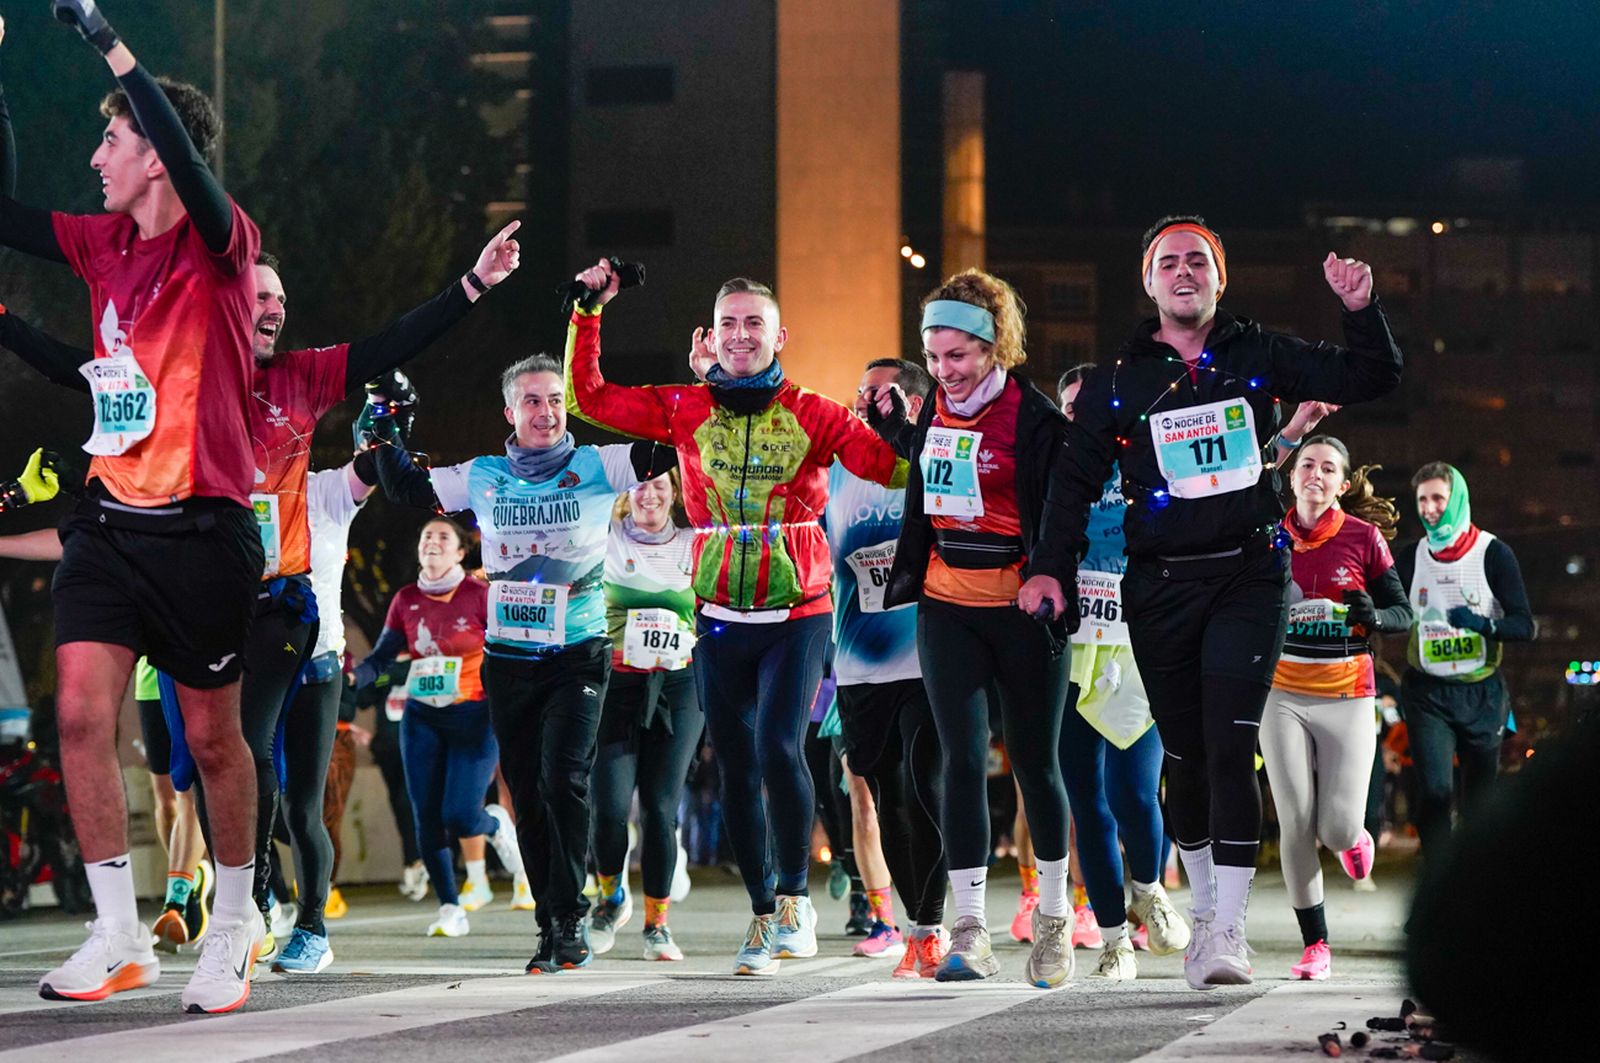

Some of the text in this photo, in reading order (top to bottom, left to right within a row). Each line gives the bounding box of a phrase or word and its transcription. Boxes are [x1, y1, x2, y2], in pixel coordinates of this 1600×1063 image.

[101, 392, 147, 422] 12562
[1174, 417, 1204, 429] NOCHE
[1205, 414, 1216, 423] DE
[1165, 431, 1184, 443] SAN
[1189, 435, 1227, 465] 171
[927, 459, 953, 486] 172
[493, 500, 581, 529] QUIEBRAJANO
[860, 559, 874, 567] SAN
[864, 551, 887, 559] NOCHE
[869, 567, 891, 587] 64
[1081, 579, 1105, 588] NOCHE
[500, 595, 514, 603] SAN
[529, 589, 537, 597] DE
[503, 604, 547, 623] 10850
[642, 629, 680, 651] 1874
[1431, 636, 1474, 657] 5843
[418, 674, 445, 692] 903
